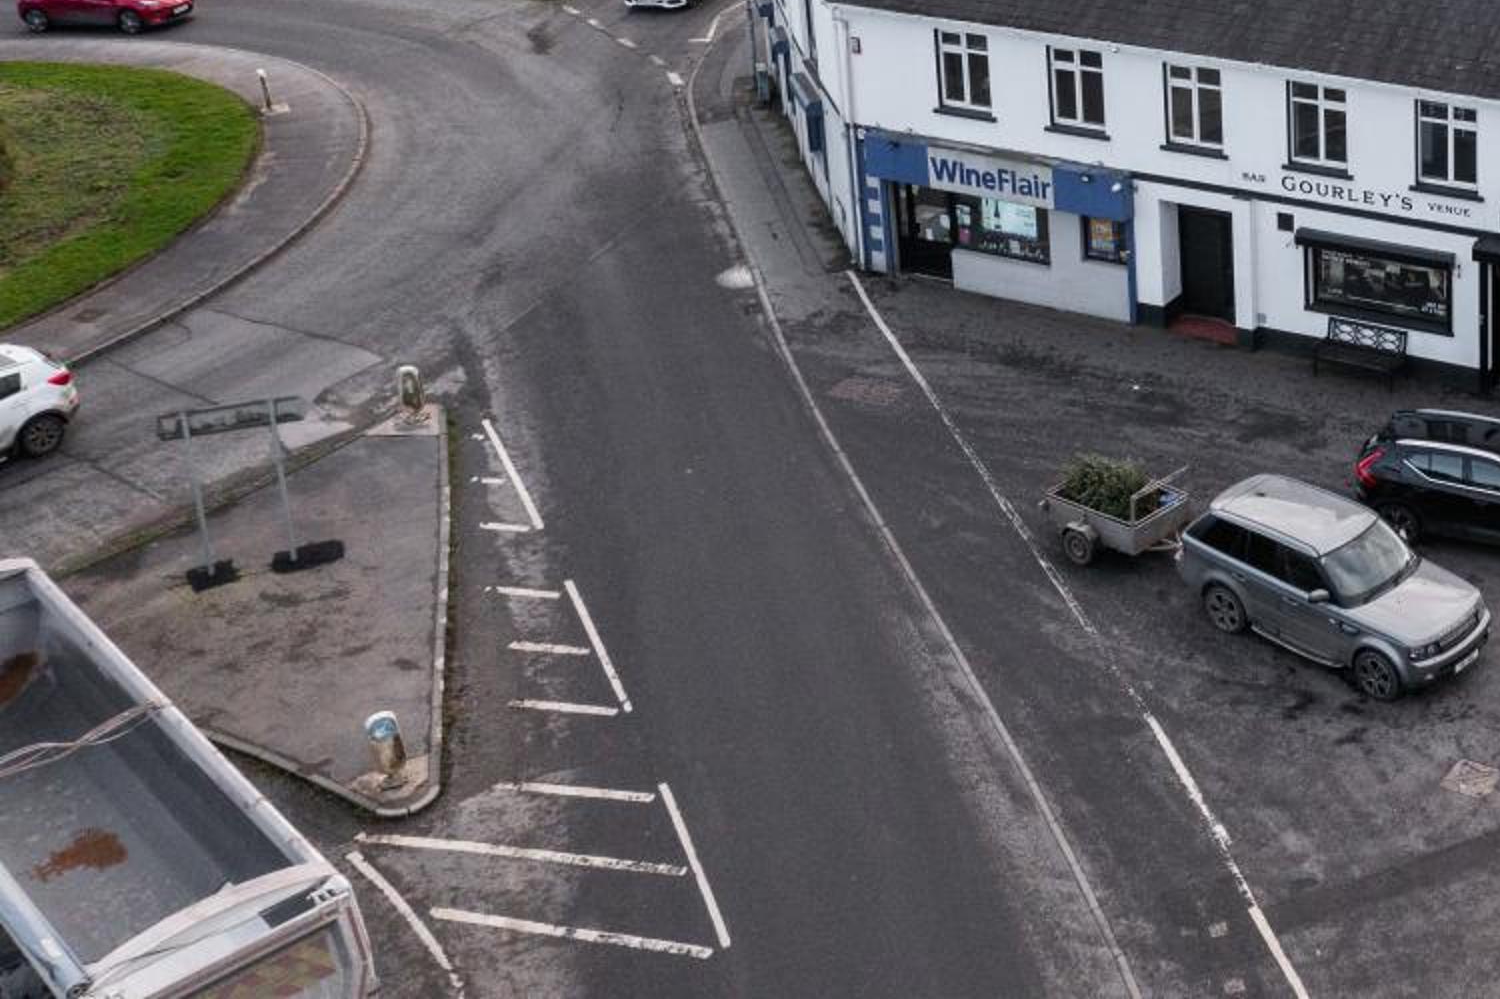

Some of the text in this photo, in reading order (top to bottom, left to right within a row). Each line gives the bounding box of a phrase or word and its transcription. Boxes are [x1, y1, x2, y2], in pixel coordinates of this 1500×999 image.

[930, 157, 1050, 200] WineFlair
[1242, 171, 1471, 218] BAR GOURLEY'S VENUE
